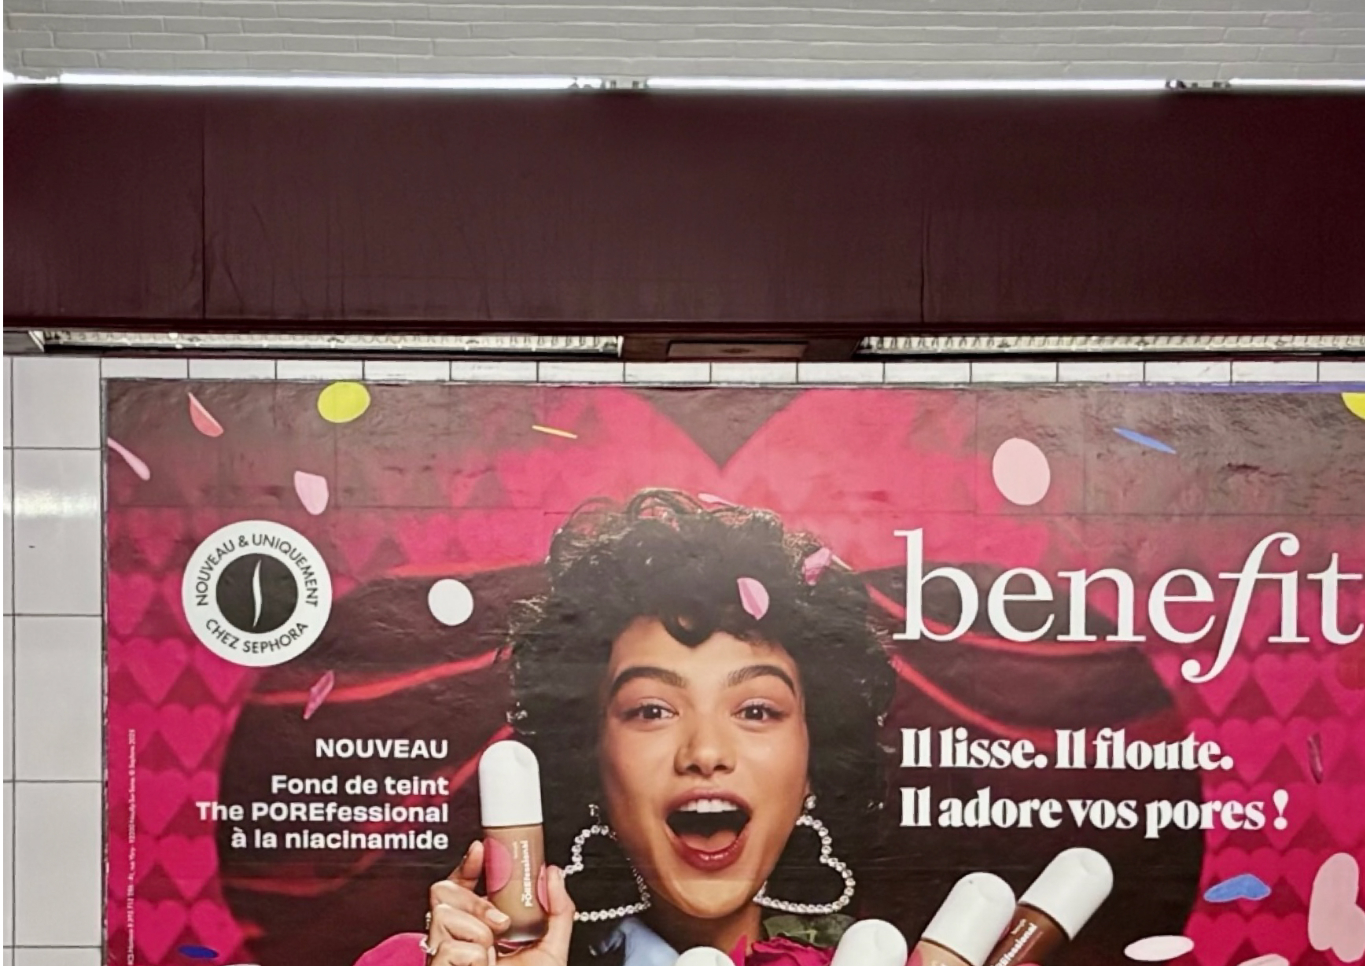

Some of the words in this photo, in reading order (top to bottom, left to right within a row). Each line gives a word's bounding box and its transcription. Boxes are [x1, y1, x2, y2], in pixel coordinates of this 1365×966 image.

[196, 539, 235, 606] NOUVEAU
[238, 535, 249, 548] &
[252, 533, 319, 607] UNIQUEMENT
[893, 529, 1364, 682] benefit
[205, 619, 240, 649] CHEZ
[242, 622, 308, 653] SEPHORA
[315, 738, 449, 759] NOUVEAU
[900, 729, 932, 769] Il
[939, 728, 1048, 769] lisse.
[1056, 729, 1087, 769] Il
[1092, 728, 1234, 770] floute.
[271, 775, 338, 794] Fond
[345, 775, 378, 794] de
[384, 776, 449, 796] teint
[196, 801, 244, 821] The
[251, 802, 449, 823] POREfessional
[900, 786, 932, 828] Il
[939, 788, 1063, 828] adore
[1073, 799, 1138, 829] vos
[1144, 797, 1264, 838] pores
[230, 826, 247, 848] à
[254, 829, 277, 848] la
[285, 829, 449, 849] niacinamide
